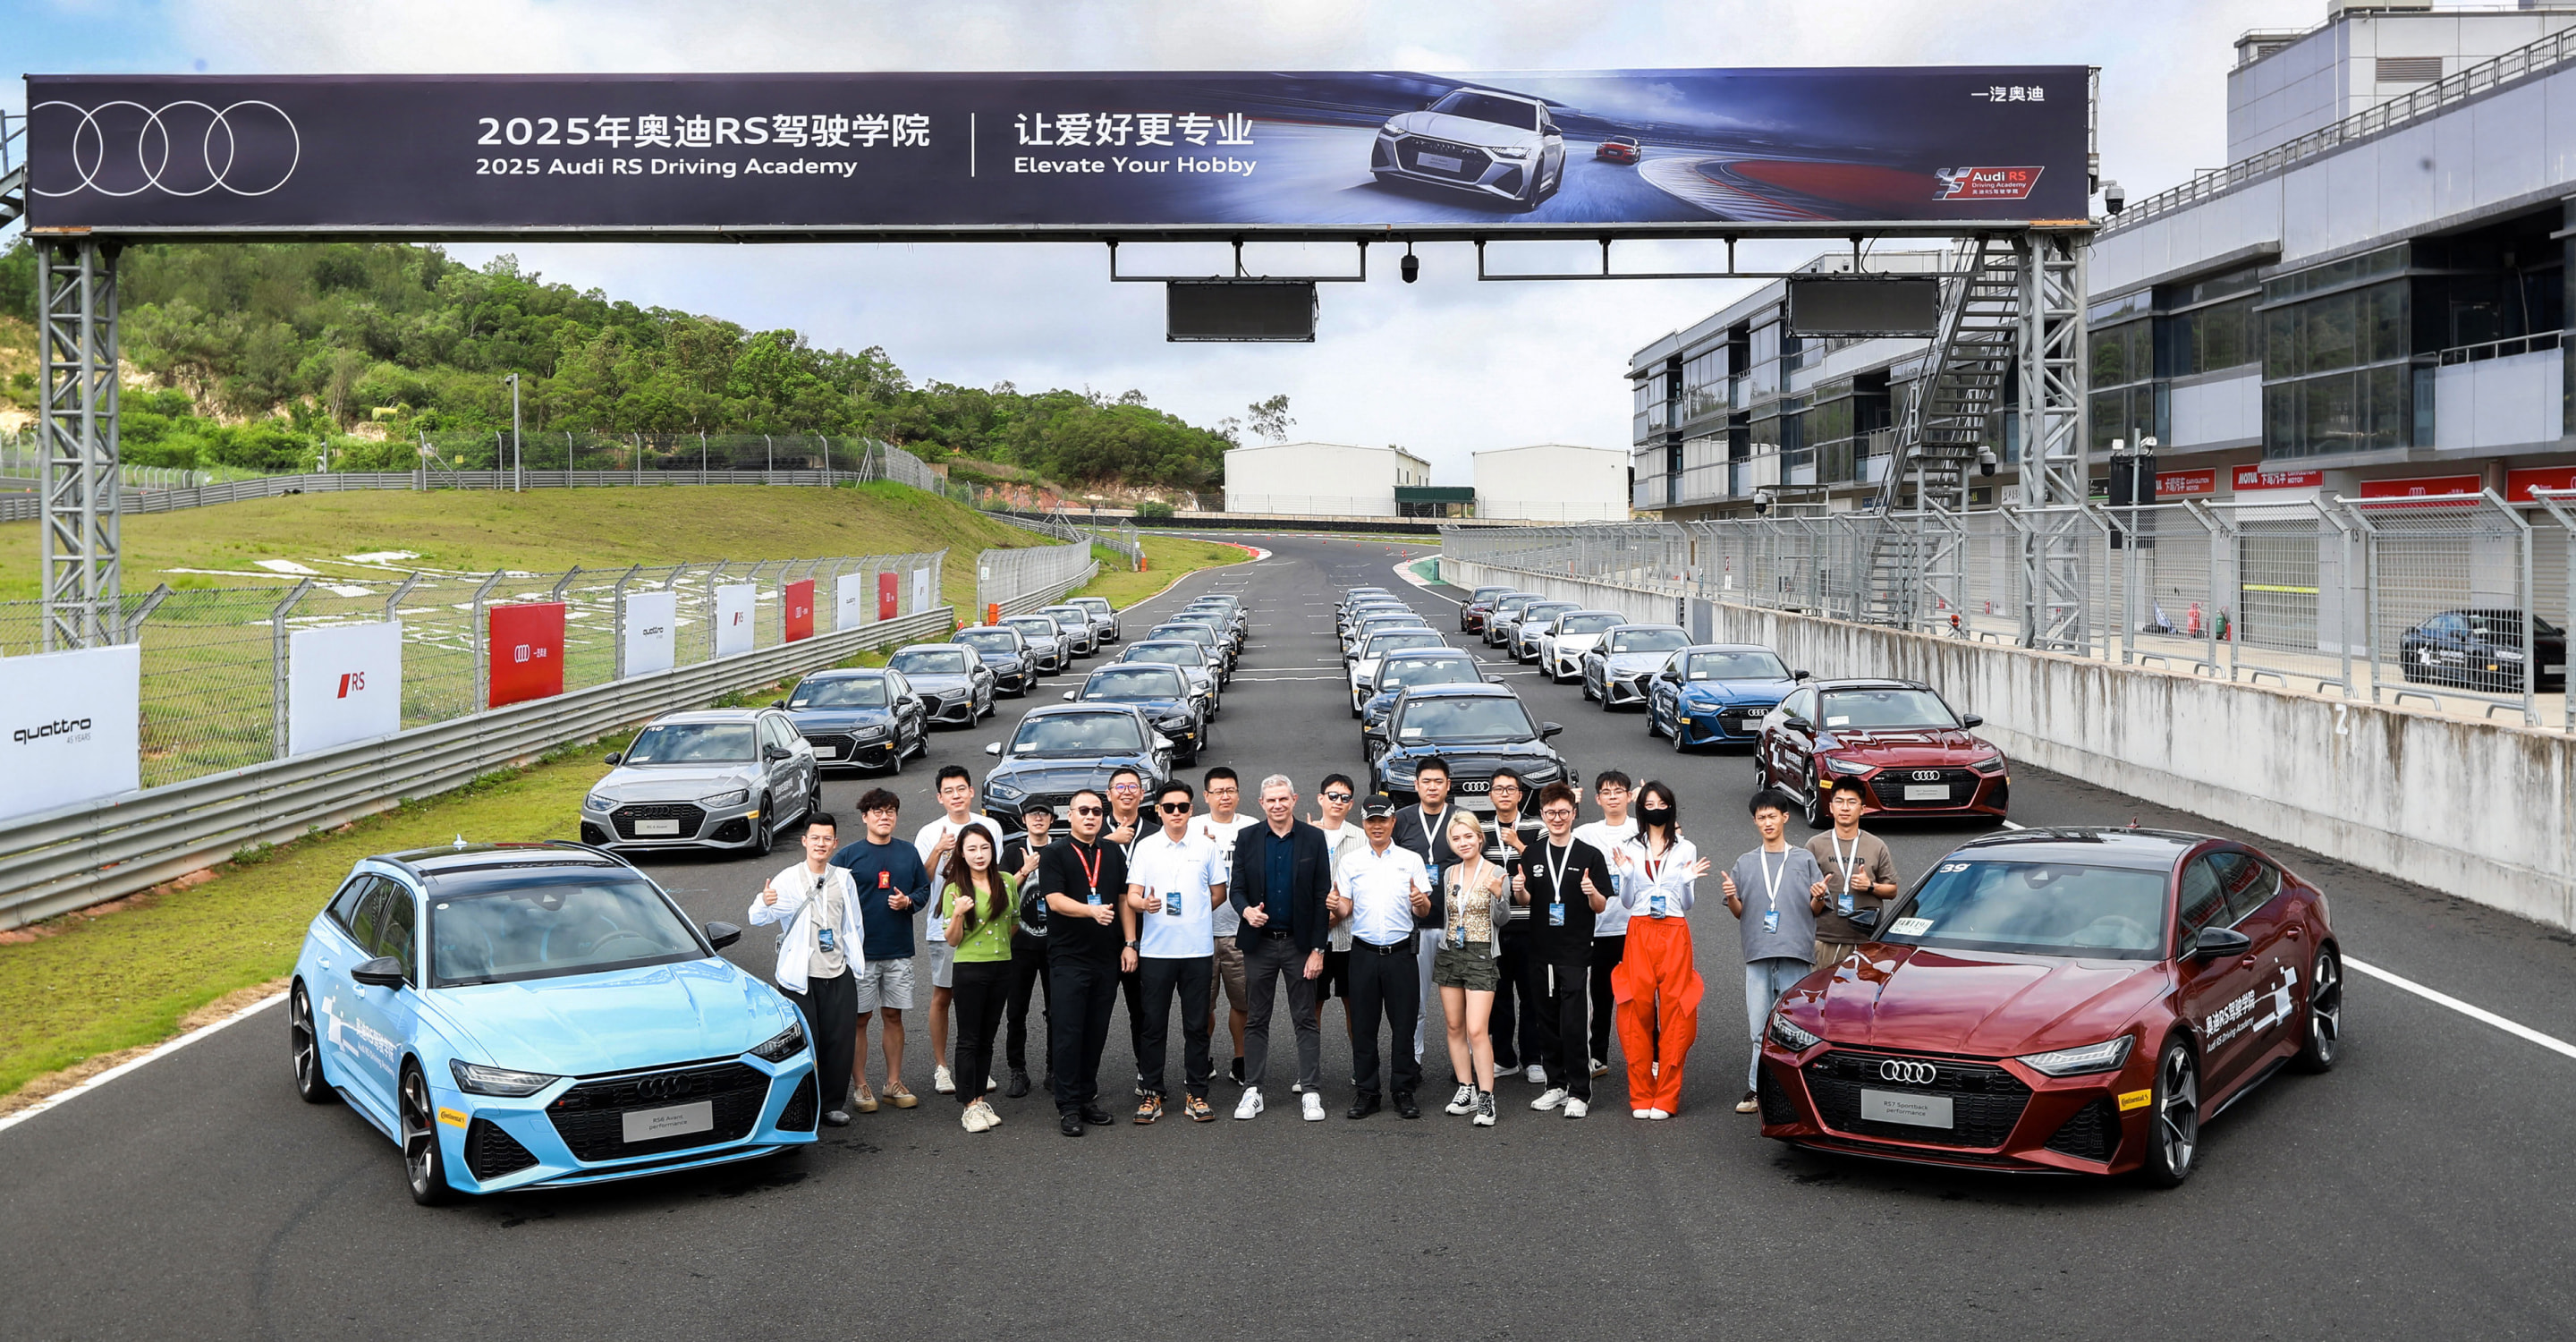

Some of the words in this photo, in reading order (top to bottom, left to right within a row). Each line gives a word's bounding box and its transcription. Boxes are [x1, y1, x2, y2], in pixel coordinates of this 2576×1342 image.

[1970, 85, 2045, 102] 一汽奥迪
[477, 114, 930, 148] 2025年奥迪RS驾驶学院
[1014, 111, 1254, 148] 让爱好更专业
[476, 157, 539, 175] 2025
[548, 157, 605, 175] Audi
[612, 157, 644, 175] RS
[650, 157, 738, 180] Driving
[743, 157, 858, 179] Academy
[1013, 157, 1103, 174] Elevate
[1111, 157, 1170, 174] Your
[1176, 157, 1258, 179] Hobby
[1971, 171, 2005, 182] Audi
[2009, 171, 2027, 181] RS
[2238, 471, 2258, 485] MOTUL
[2287, 476, 2304, 484] MOTOR
[642, 626, 664, 637] quattro
[352, 671, 365, 691] RS
[13, 718, 91, 745] quattro
[66, 735, 73, 744] 45
[74, 732, 91, 743] YEARS
[1939, 862, 1971, 873] 39
[1885, 1108, 1926, 1117] performance
[1897, 1102, 1928, 1111] Sportback
[665, 1114, 683, 1122] Avant
[648, 1119, 688, 1131] performance
